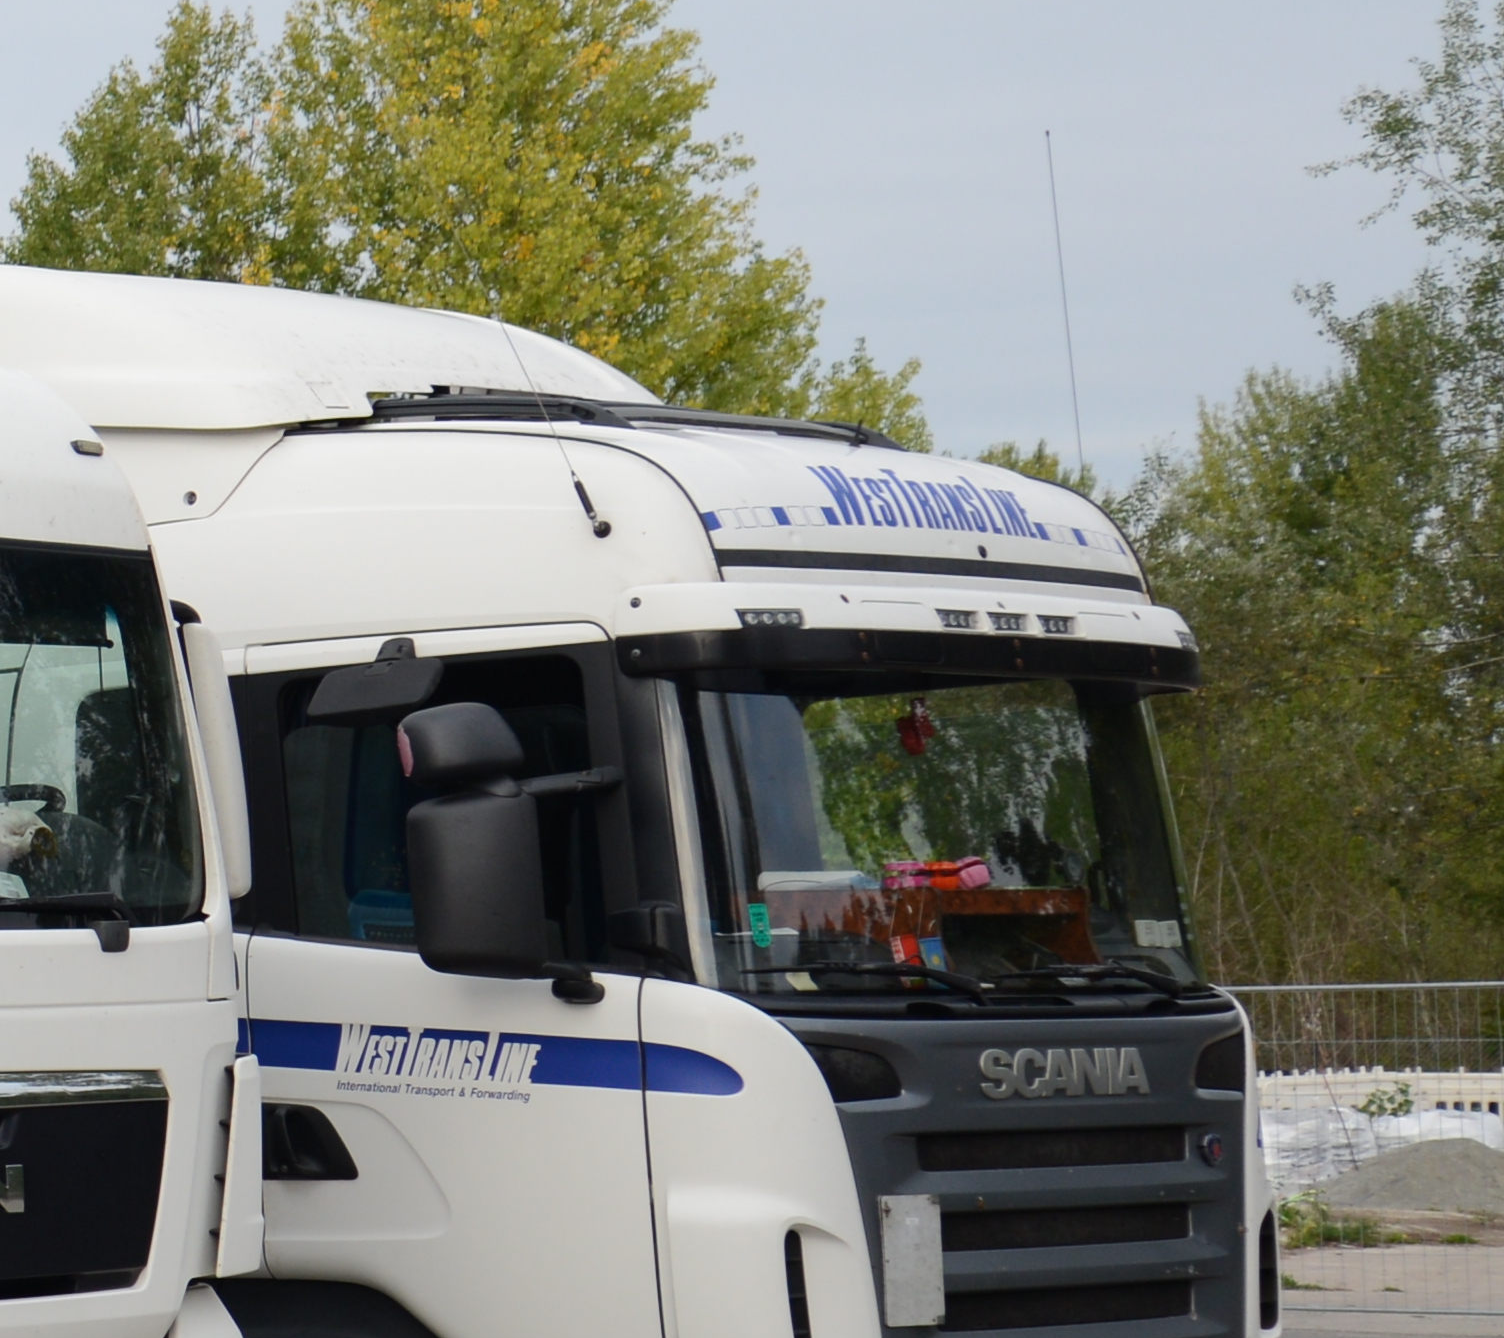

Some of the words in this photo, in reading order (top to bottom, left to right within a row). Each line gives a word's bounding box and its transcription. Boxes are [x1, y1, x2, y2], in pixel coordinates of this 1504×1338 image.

[336, 1079, 402, 1095] International
[405, 1083, 456, 1099] Transport
[458, 1087, 467, 1098] &
[469, 1087, 532, 1104] Forwarding
[979, 1047, 1151, 1100] SCANIA
